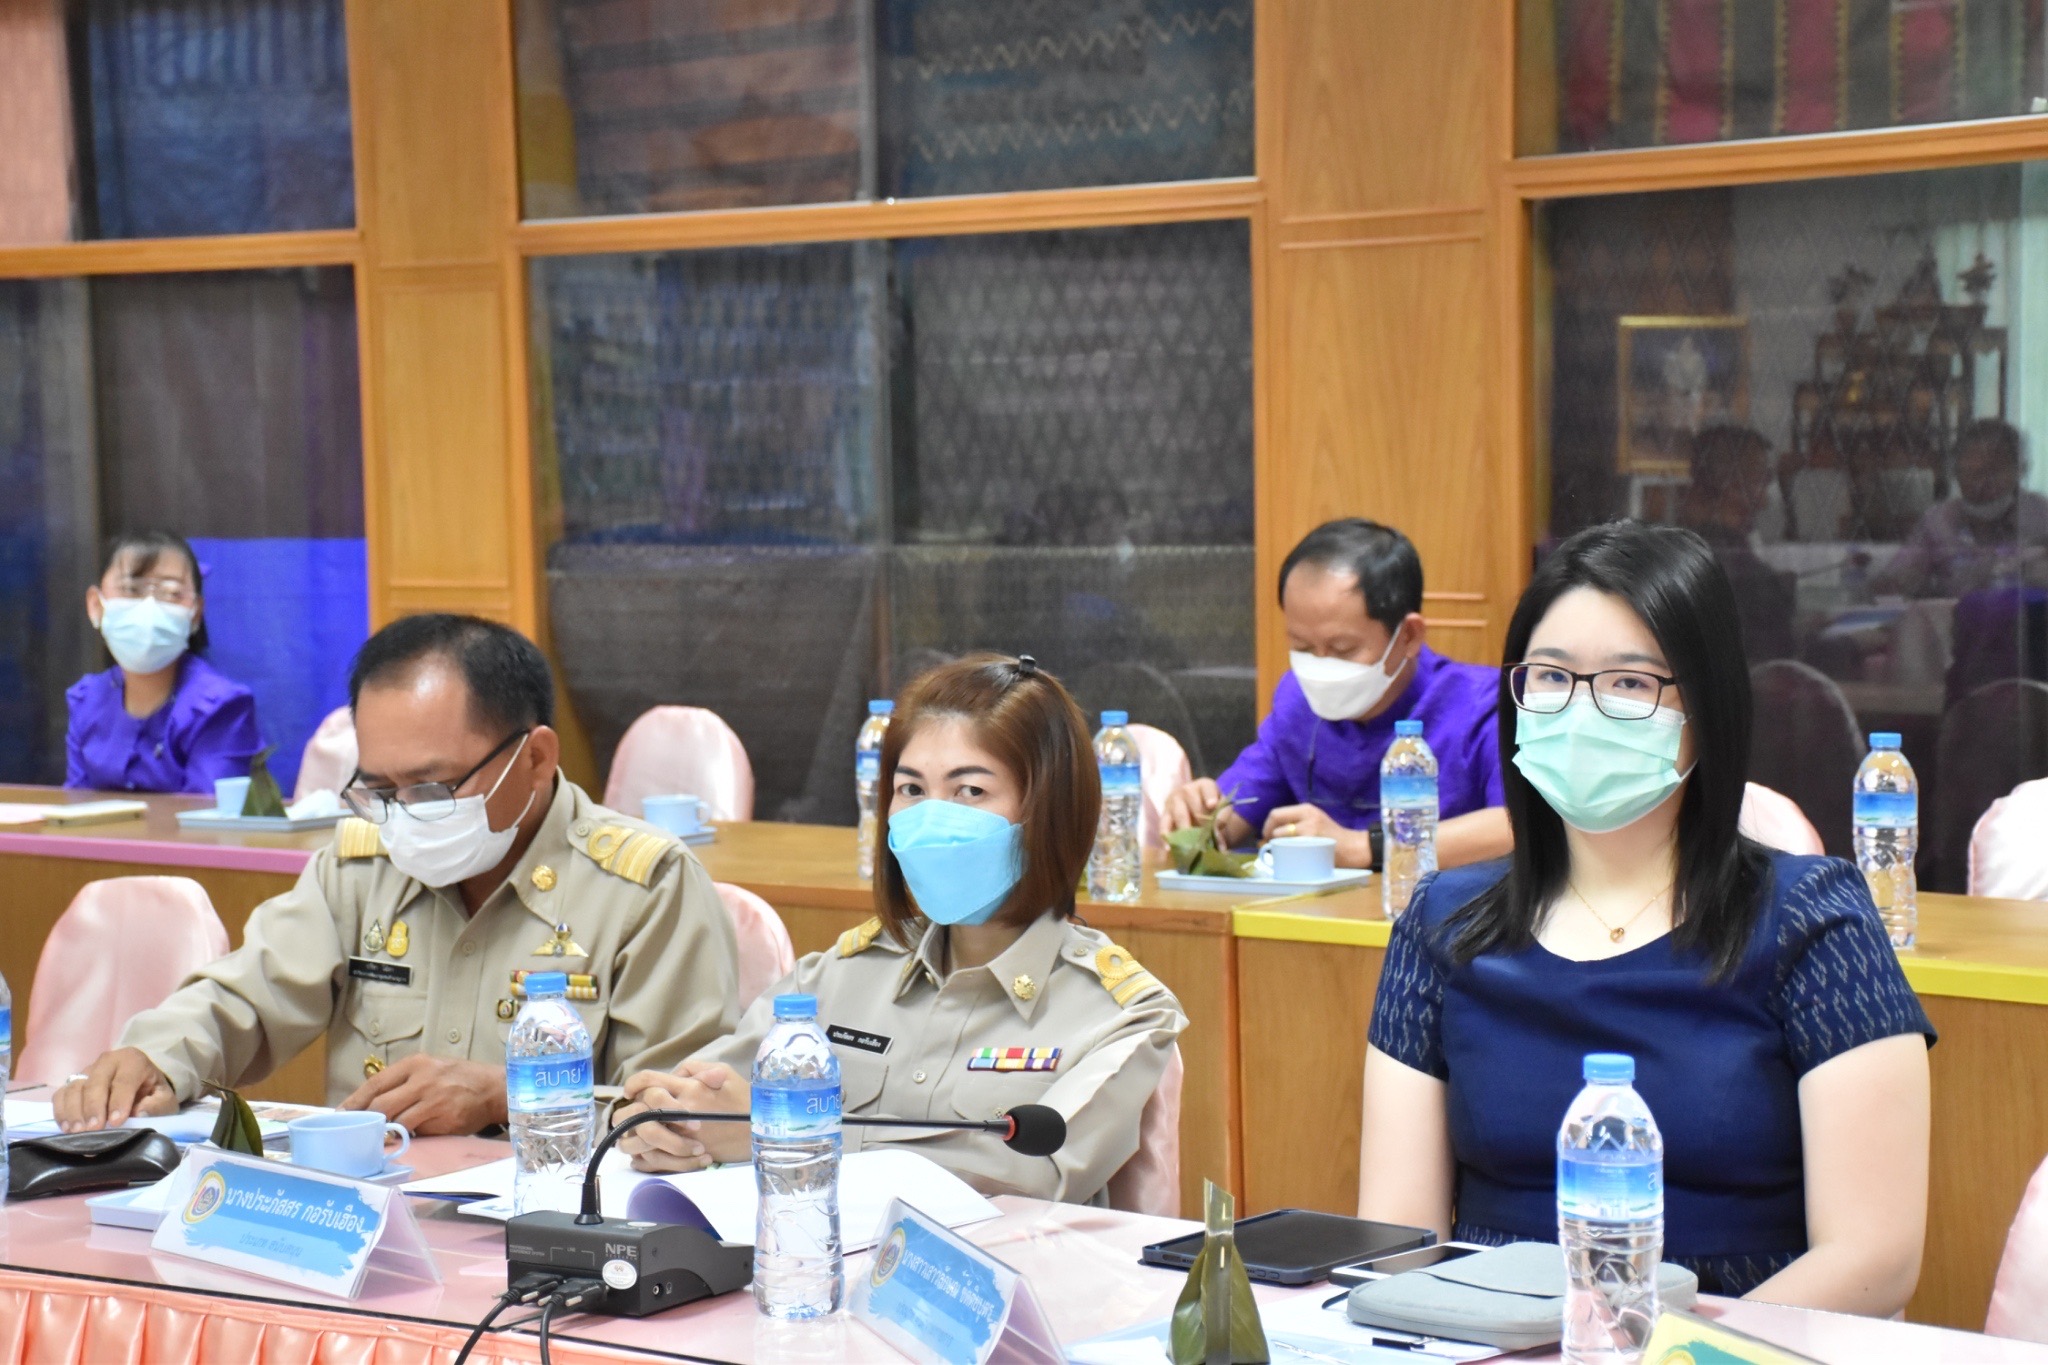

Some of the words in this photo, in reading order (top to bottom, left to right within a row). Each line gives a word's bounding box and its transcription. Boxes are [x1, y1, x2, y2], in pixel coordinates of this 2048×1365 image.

[535, 1067, 581, 1088] สบาย
[225, 1187, 302, 1219] นางประภัสสร
[605, 1242, 637, 1257] NPE
